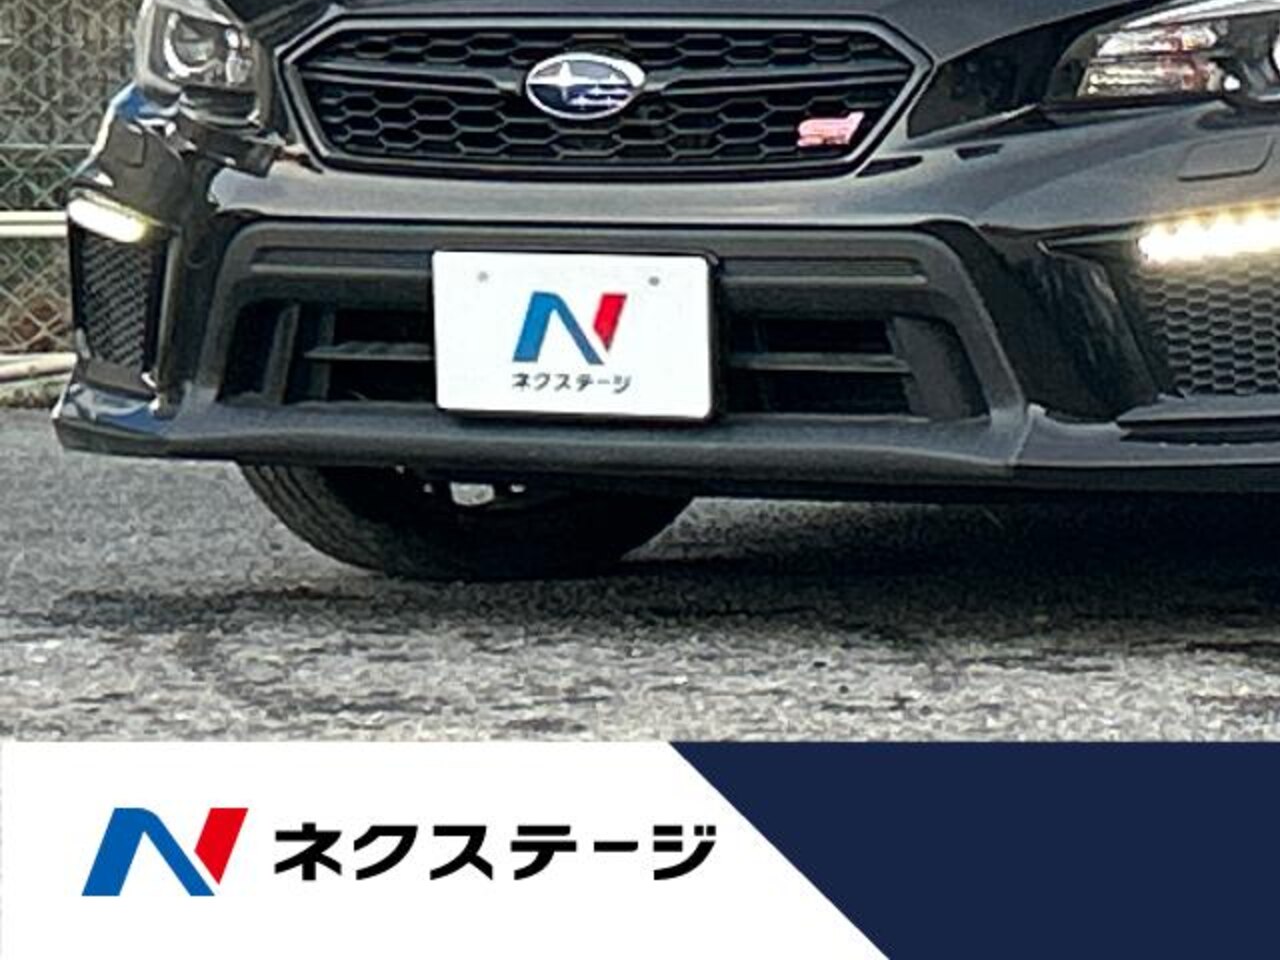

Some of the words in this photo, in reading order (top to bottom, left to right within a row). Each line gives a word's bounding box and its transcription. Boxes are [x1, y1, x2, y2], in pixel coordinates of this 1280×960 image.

[511, 372, 632, 394] ネクステージ
